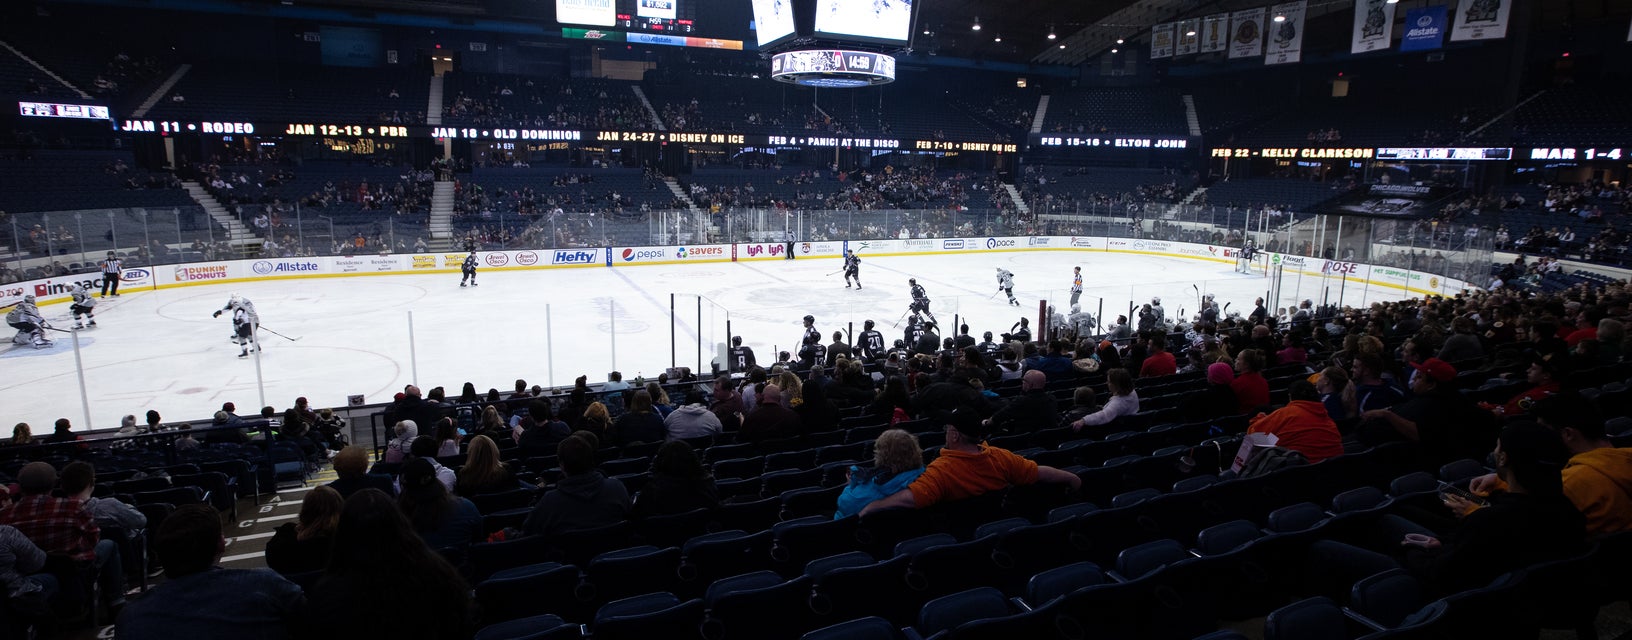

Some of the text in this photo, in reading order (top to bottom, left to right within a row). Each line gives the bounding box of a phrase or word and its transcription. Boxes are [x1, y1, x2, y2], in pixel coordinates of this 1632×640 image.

[1406, 26, 1439, 38] Allstate
[122, 120, 254, 134] JAN 11 RODEO
[286, 124, 408, 137] JAN 12-13 PBR
[431, 127, 581, 140] JAN 18 OLD DOMINION
[597, 131, 745, 144] JAN 24-27 DISNEY ON ICE
[768, 136, 788, 145] FEB
[790, 136, 796, 145] 4
[841, 138, 854, 147] AT
[855, 138, 871, 148] THE
[873, 139, 899, 148] DISCO
[916, 140, 1017, 152] FEB 7-10 DISNEY ON ICE
[1041, 137, 1187, 148] FEB 15-16 ELTON JOHN
[1211, 148, 1232, 157] FEB
[1234, 148, 1250, 157] 22
[1262, 148, 1298, 157] KELLY
[1301, 148, 1373, 158] CLARKSON
[1530, 148, 1621, 160] MAR 1-4
[1400, 185, 1431, 193] WOLVES
[768, 243, 784, 256] lyft
[997, 239, 1015, 248] pace
[555, 249, 594, 263] Hefty
[637, 249, 665, 260] pepsi
[689, 246, 723, 255] savers
[747, 244, 763, 256] lyft
[189, 265, 228, 274] DUNKIN'
[274, 261, 318, 272] Allstate
[123, 271, 144, 280] AHL
[189, 271, 227, 280] DONUTS
[47, 278, 103, 296] imac
[868, 336, 881, 350] 20
[738, 355, 746, 368] 8
[270, 495, 282, 503] A
[259, 505, 273, 513] B
[238, 519, 255, 528] C
